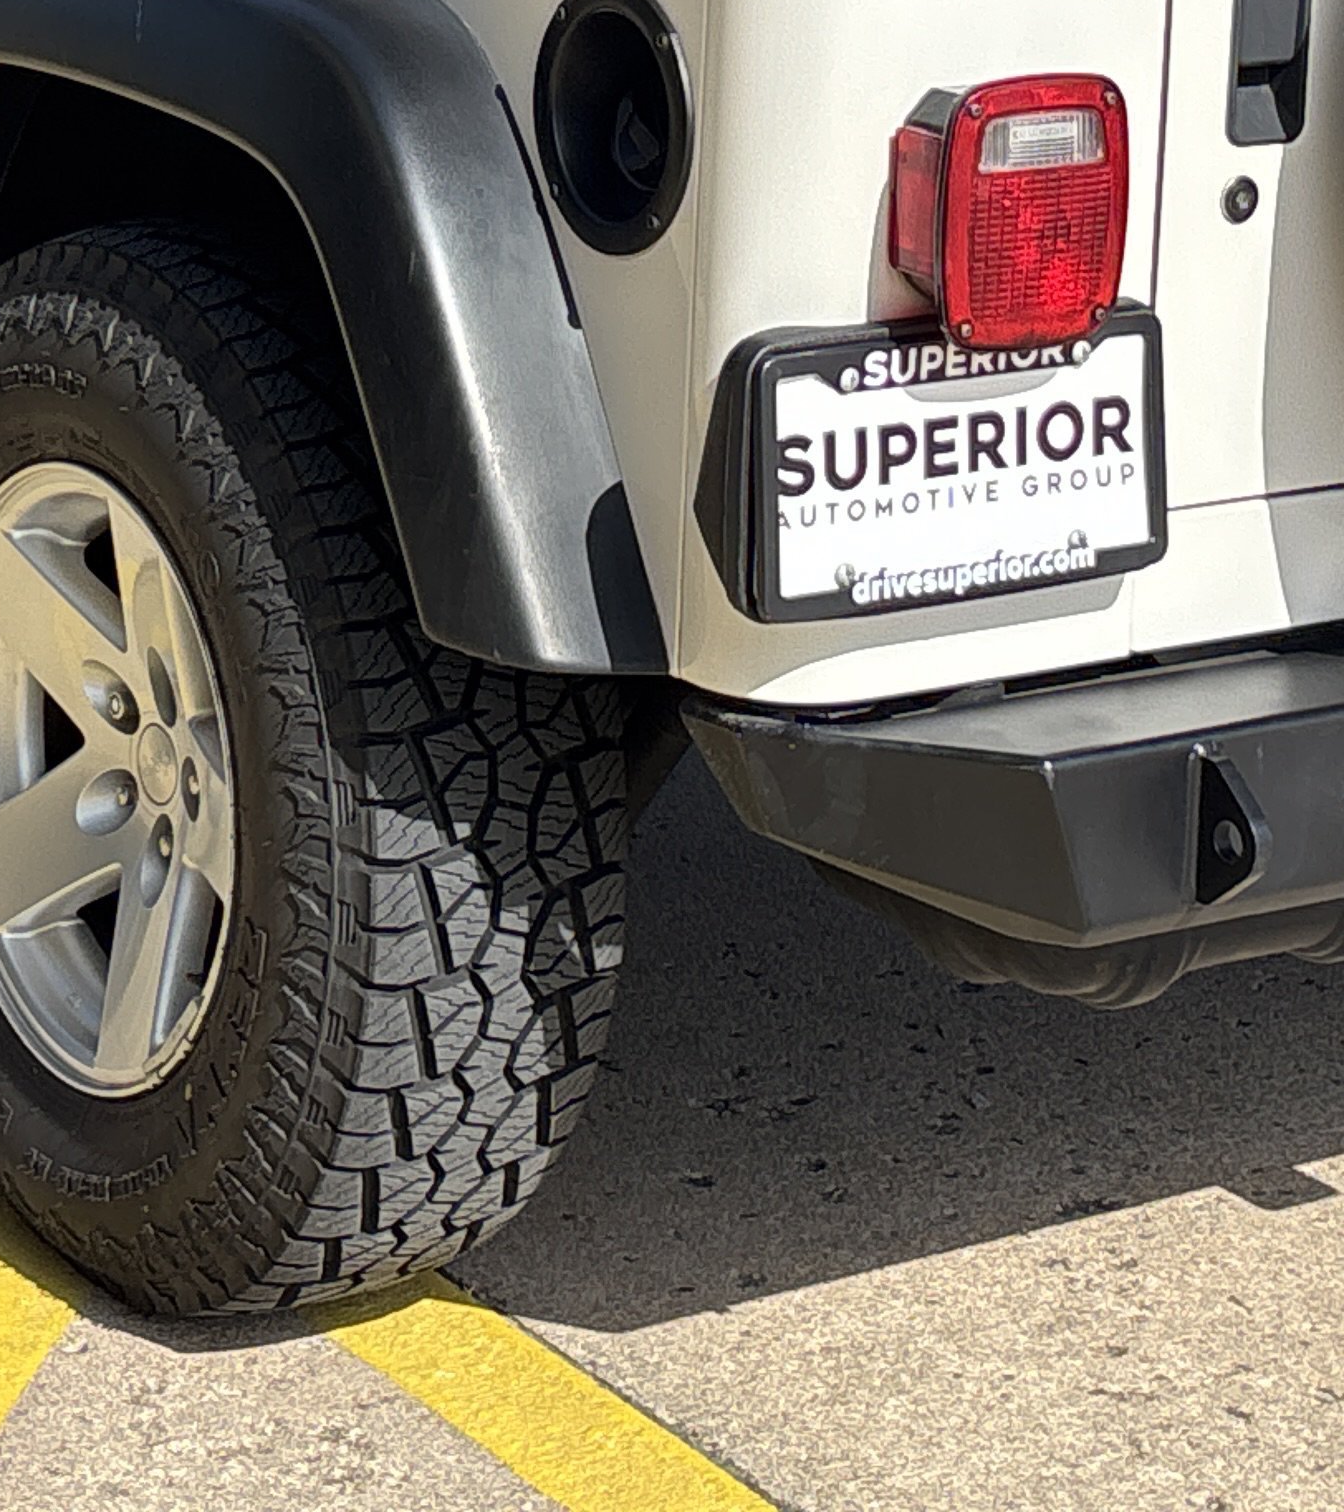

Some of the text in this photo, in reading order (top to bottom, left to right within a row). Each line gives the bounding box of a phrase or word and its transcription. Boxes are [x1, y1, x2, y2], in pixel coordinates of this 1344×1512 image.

[776, 395, 1133, 498] SUPERIOR
[777, 463, 1134, 529] AUTOMOTIVE GROUP
[852, 548, 1097, 605] drivesuperior.com
